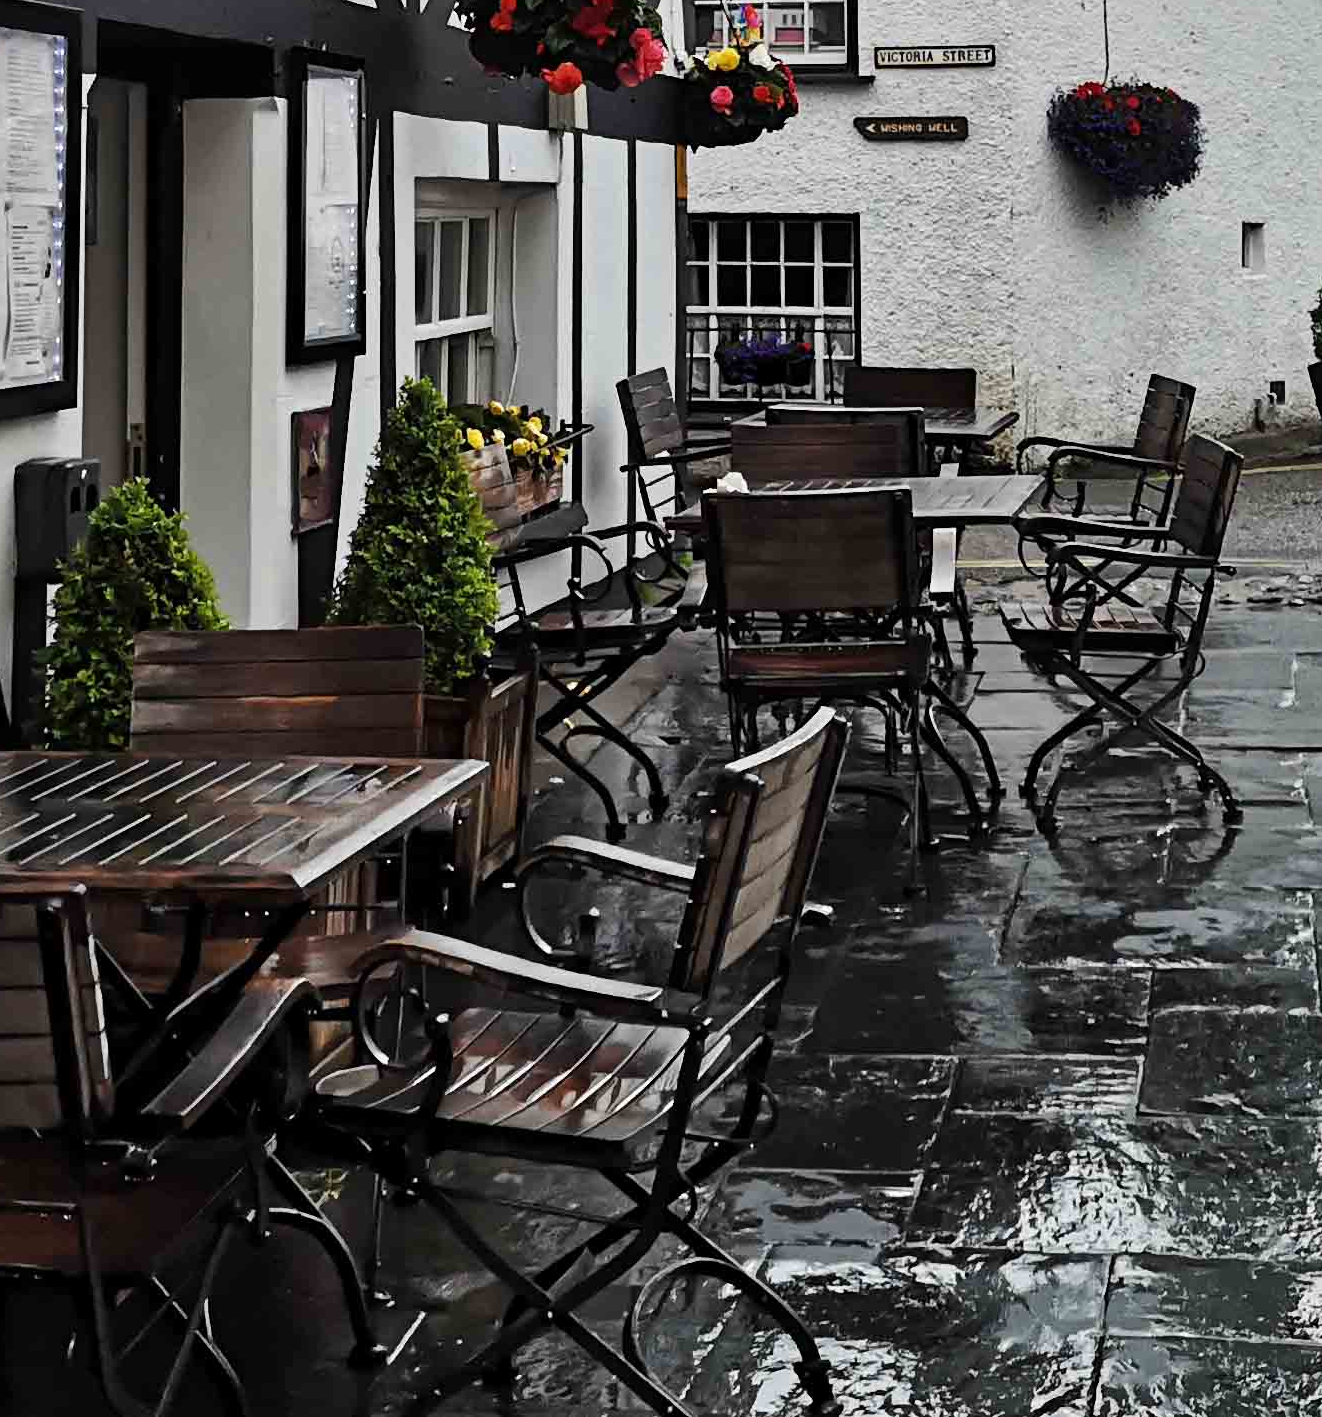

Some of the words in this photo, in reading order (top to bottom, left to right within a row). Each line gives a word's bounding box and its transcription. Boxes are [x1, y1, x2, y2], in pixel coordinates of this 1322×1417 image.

[879, 50, 934, 63] VICTORIA
[942, 49, 991, 62] STREET
[880, 122, 923, 133] WISHING
[928, 122, 958, 133] WELL
